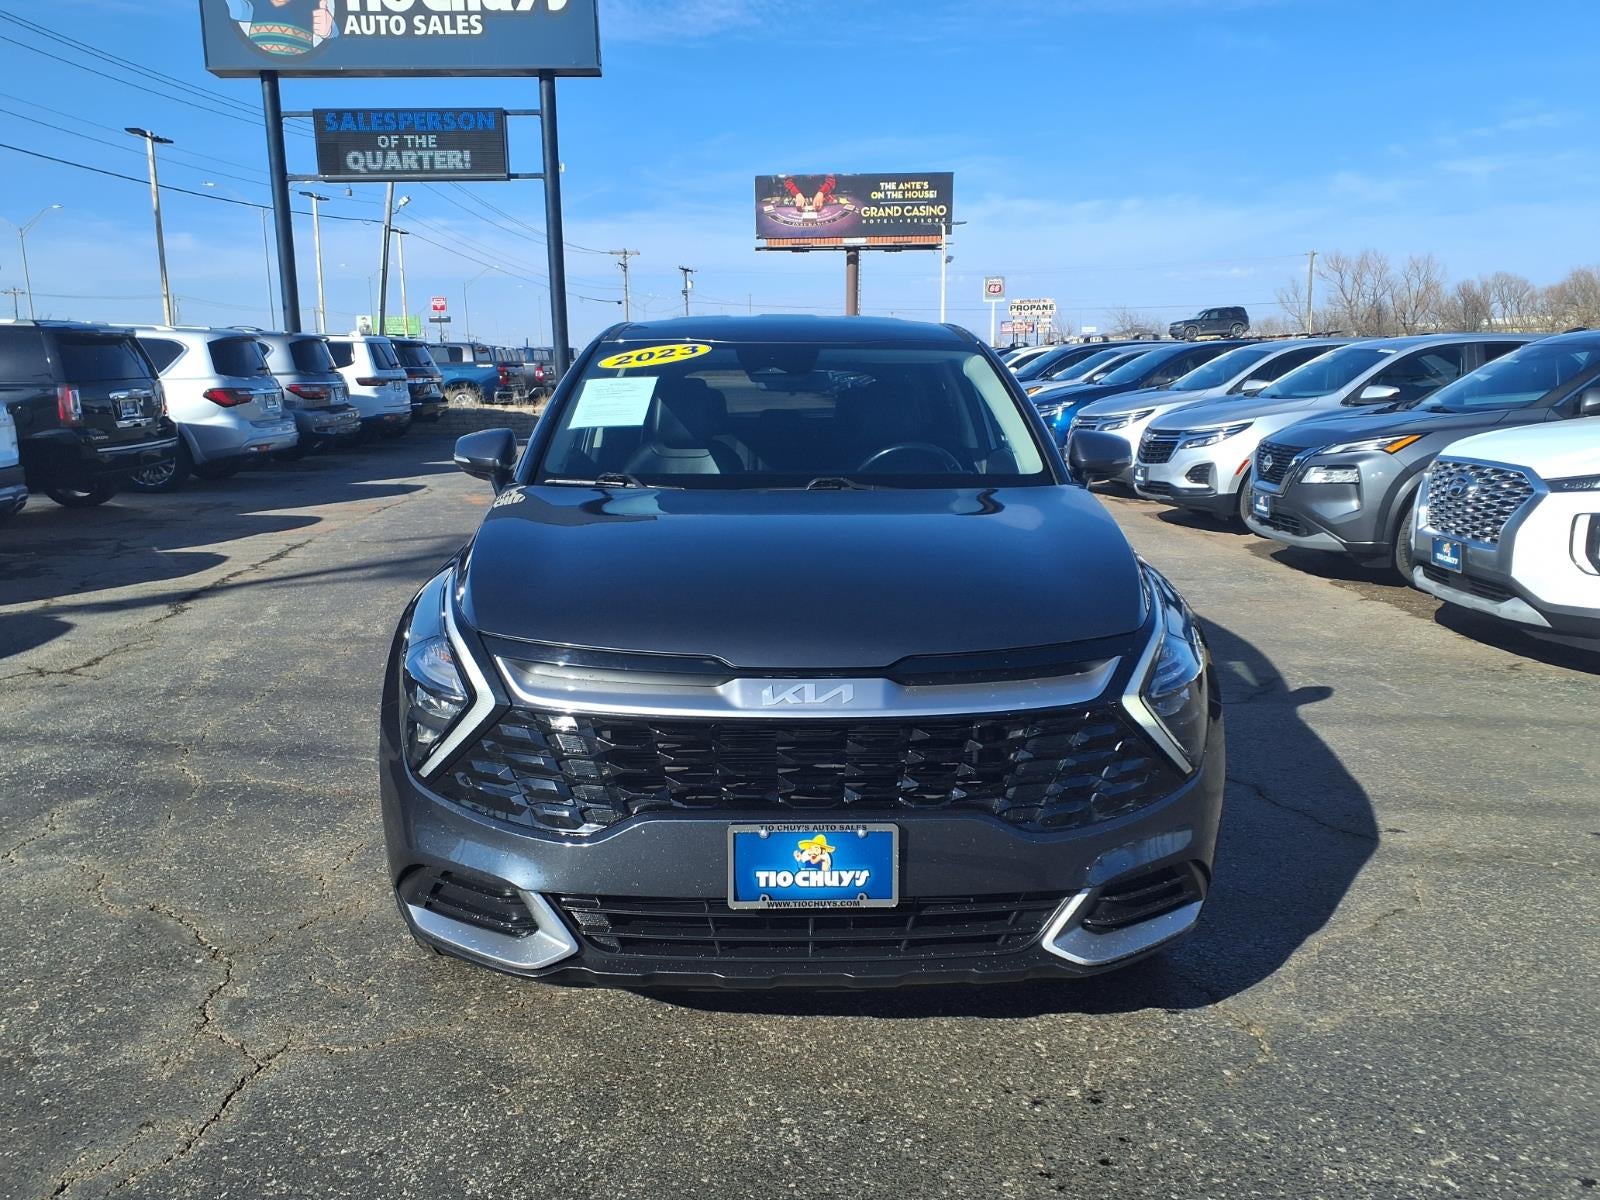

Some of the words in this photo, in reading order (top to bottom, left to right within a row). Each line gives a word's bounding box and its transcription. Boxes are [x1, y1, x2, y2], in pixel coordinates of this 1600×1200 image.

[343, 14, 407, 36] AUTO
[413, 14, 483, 36] SALES
[325, 111, 496, 131] SALESPERSON
[377, 135, 400, 149] OF
[403, 134, 438, 148] THE
[345, 150, 472, 174] QUARTER!
[880, 182, 897, 190] THE
[898, 181, 929, 189] ANTE'S
[871, 191, 885, 199] ON
[886, 191, 903, 199] THE
[905, 190, 937, 198] HOUSE!
[860, 205, 902, 218] GRAND
[903, 203, 947, 217] CASINO
[989, 284, 1001, 293] 66
[1009, 303, 1056, 312] PROPANE
[612, 345, 699, 366] 2023
[761, 683, 854, 706] KIA
[759, 824, 775, 832] TIO
[777, 824, 810, 832] CHUY'S
[766, 900, 861, 908] WWW.TIOCHUYS.COM
